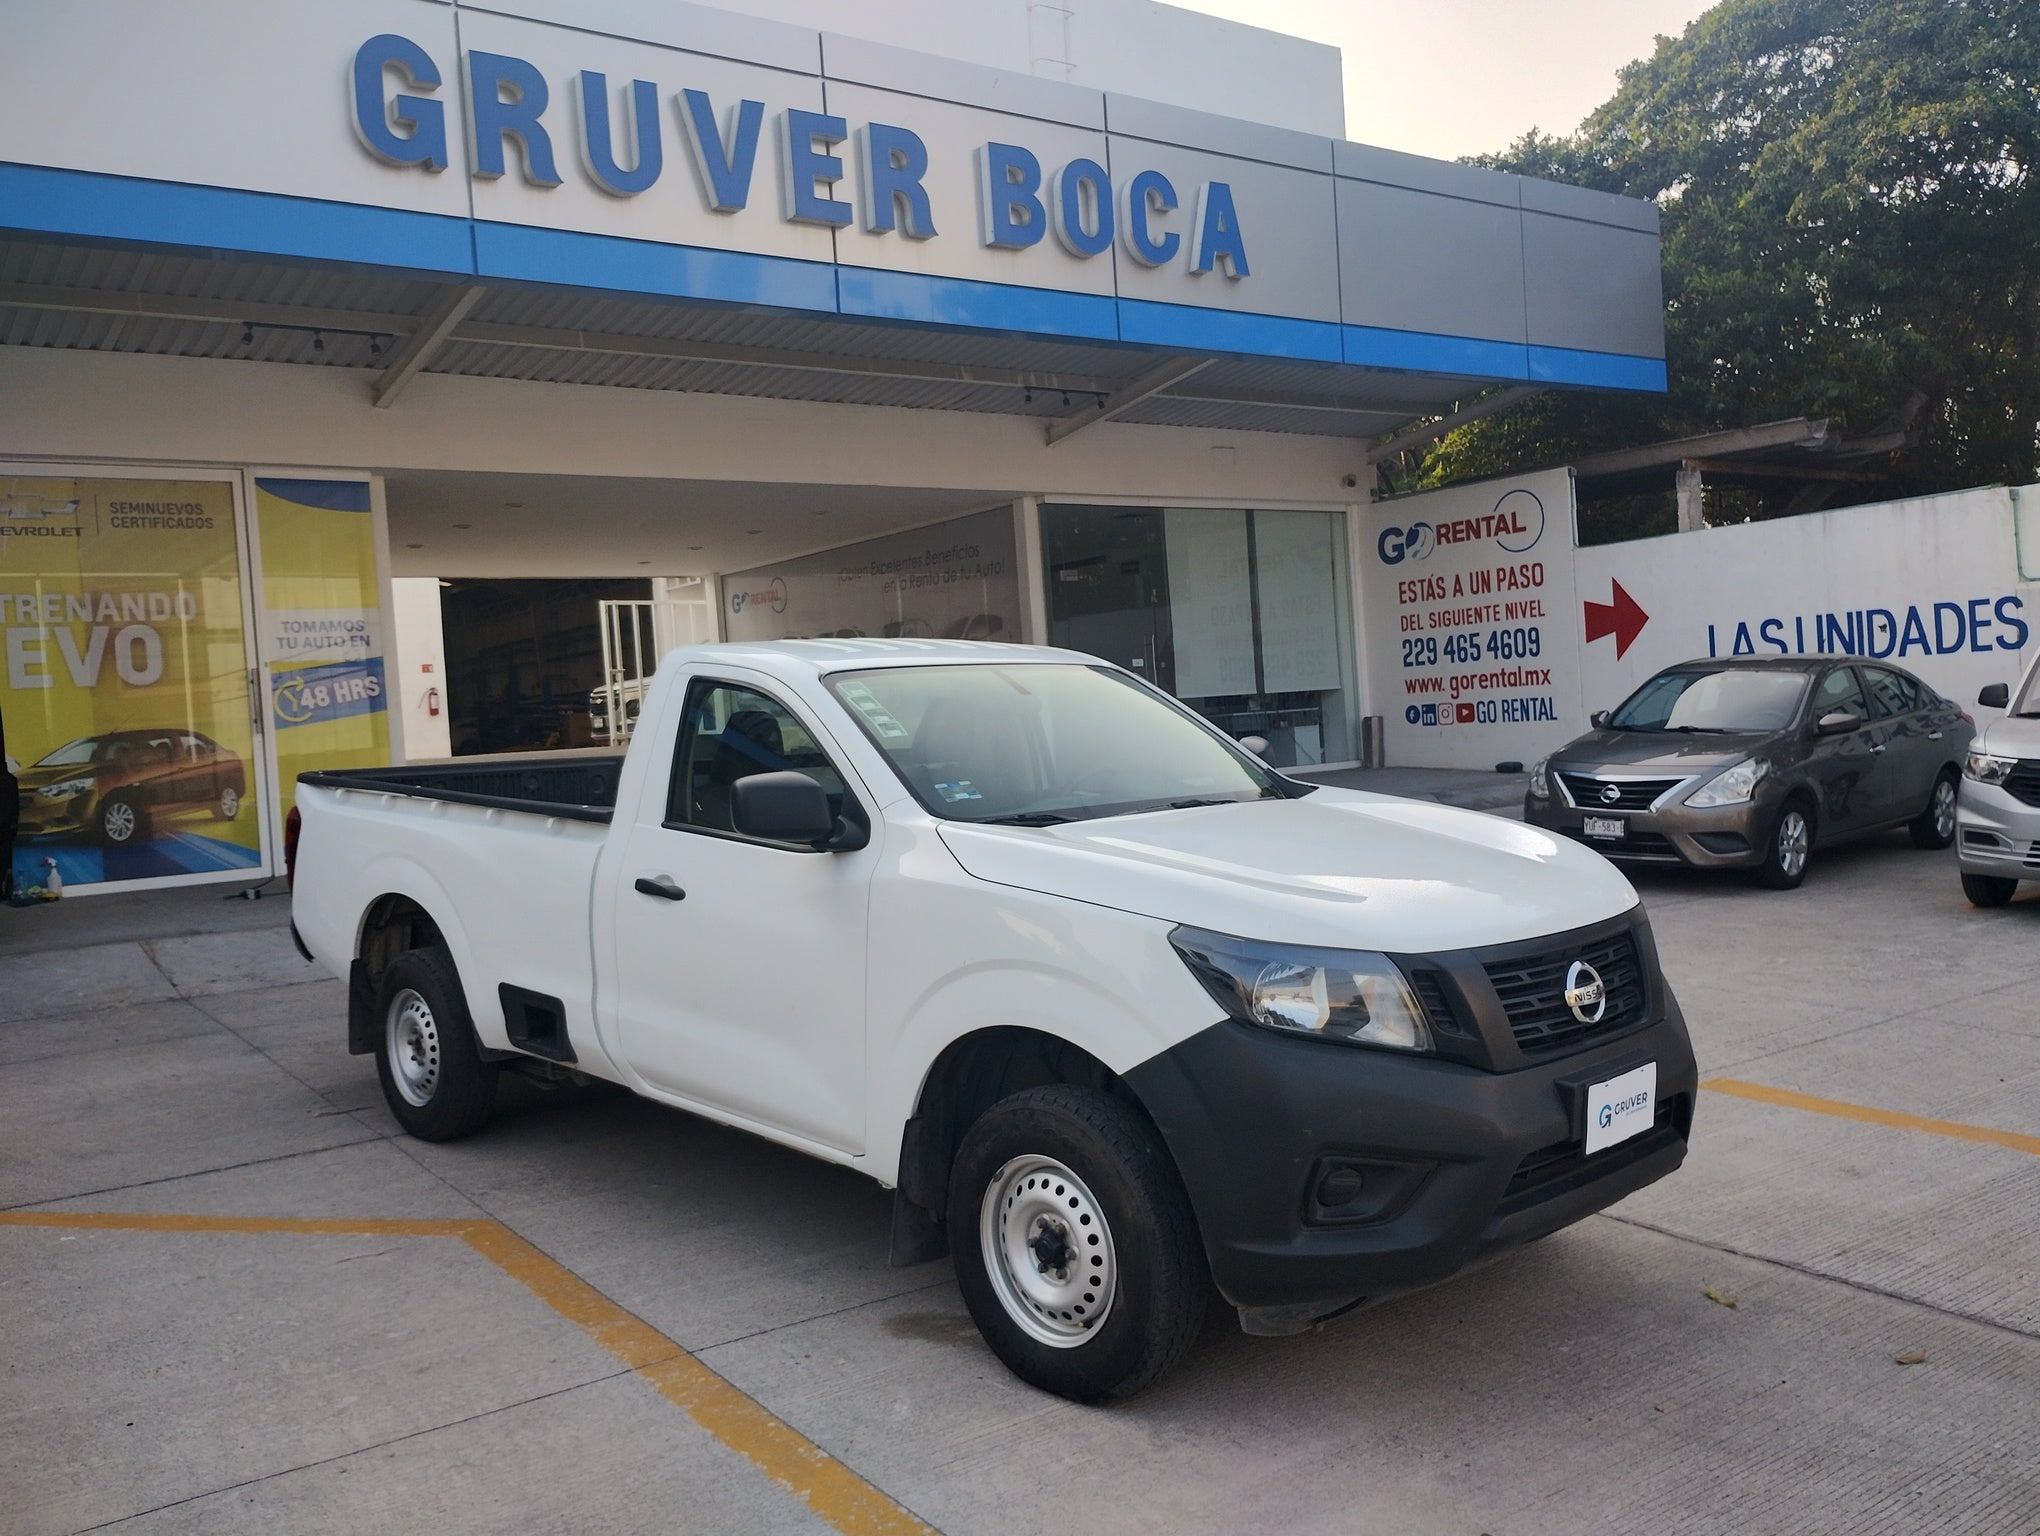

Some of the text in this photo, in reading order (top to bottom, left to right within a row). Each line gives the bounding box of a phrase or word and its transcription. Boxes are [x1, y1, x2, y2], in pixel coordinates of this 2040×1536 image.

[349, 34, 1250, 280] GRUVER BOCA
[109, 501, 205, 516] SEMINUEVOS
[111, 515, 214, 530] CERTIFICADOS
[1436, 512, 1527, 546] RENTAL
[925, 543, 980, 566] Beneficios
[910, 572, 939, 589] Renta
[1399, 562, 1545, 604] ESTÁS A UN PASO
[281, 619, 366, 634] TOMAMOS
[1400, 599, 1546, 632] DEL SIGUIENTE NIVEL
[1796, 596, 2029, 658] UNIDADES
[277, 635, 371, 650] TU AUTO EN
[1402, 627, 1541, 667] 229 465 4609
[6, 624, 166, 689] EVO
[300, 676, 381, 709] 48 HRS
[1476, 701, 1497, 723] GO
[1502, 697, 1557, 722] RENTAL
[1574, 984, 1602, 1003] NISS
[1614, 1091, 1648, 1116] GRUVER
